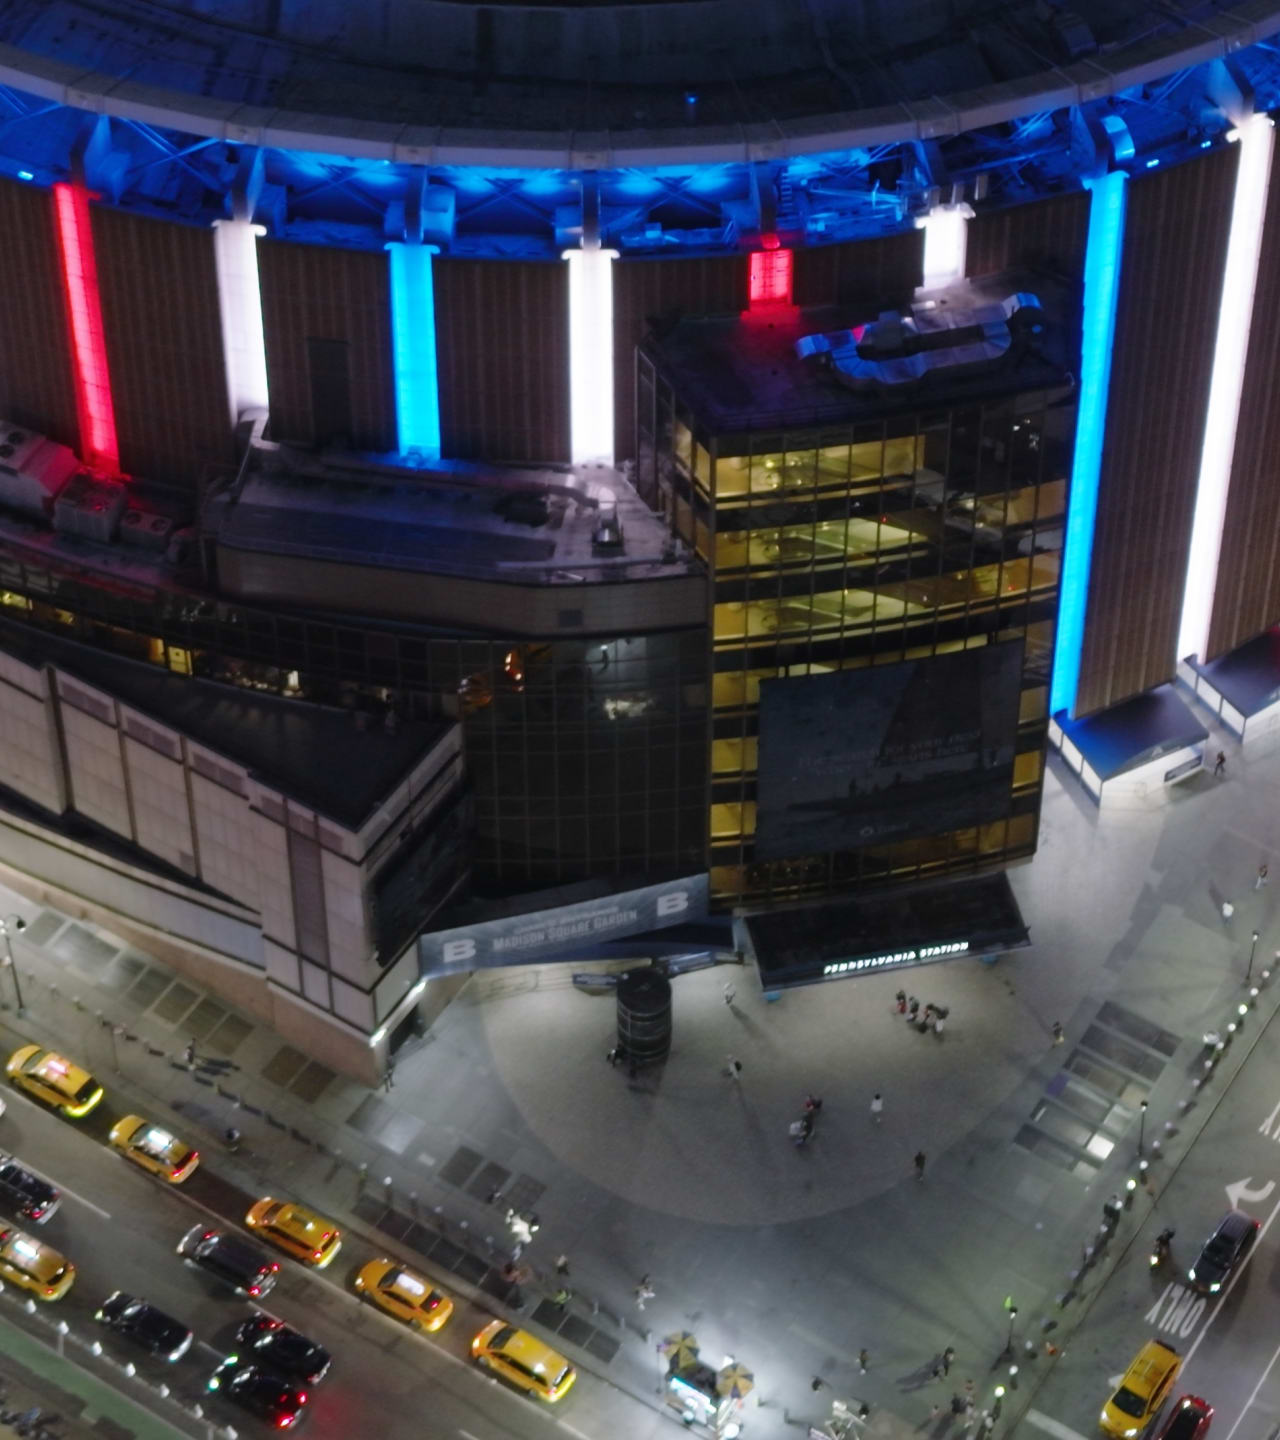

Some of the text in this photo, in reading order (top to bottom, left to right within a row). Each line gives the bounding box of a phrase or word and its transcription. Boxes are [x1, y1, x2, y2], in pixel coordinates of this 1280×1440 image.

[493, 930, 545, 951] MADISON
[548, 920, 591, 940] SQUARE
[594, 910, 638, 929] GARDEN
[823, 941, 969, 975] PENNSYLVANIA STATION
[1144, 1282, 1207, 1338] ONLY
